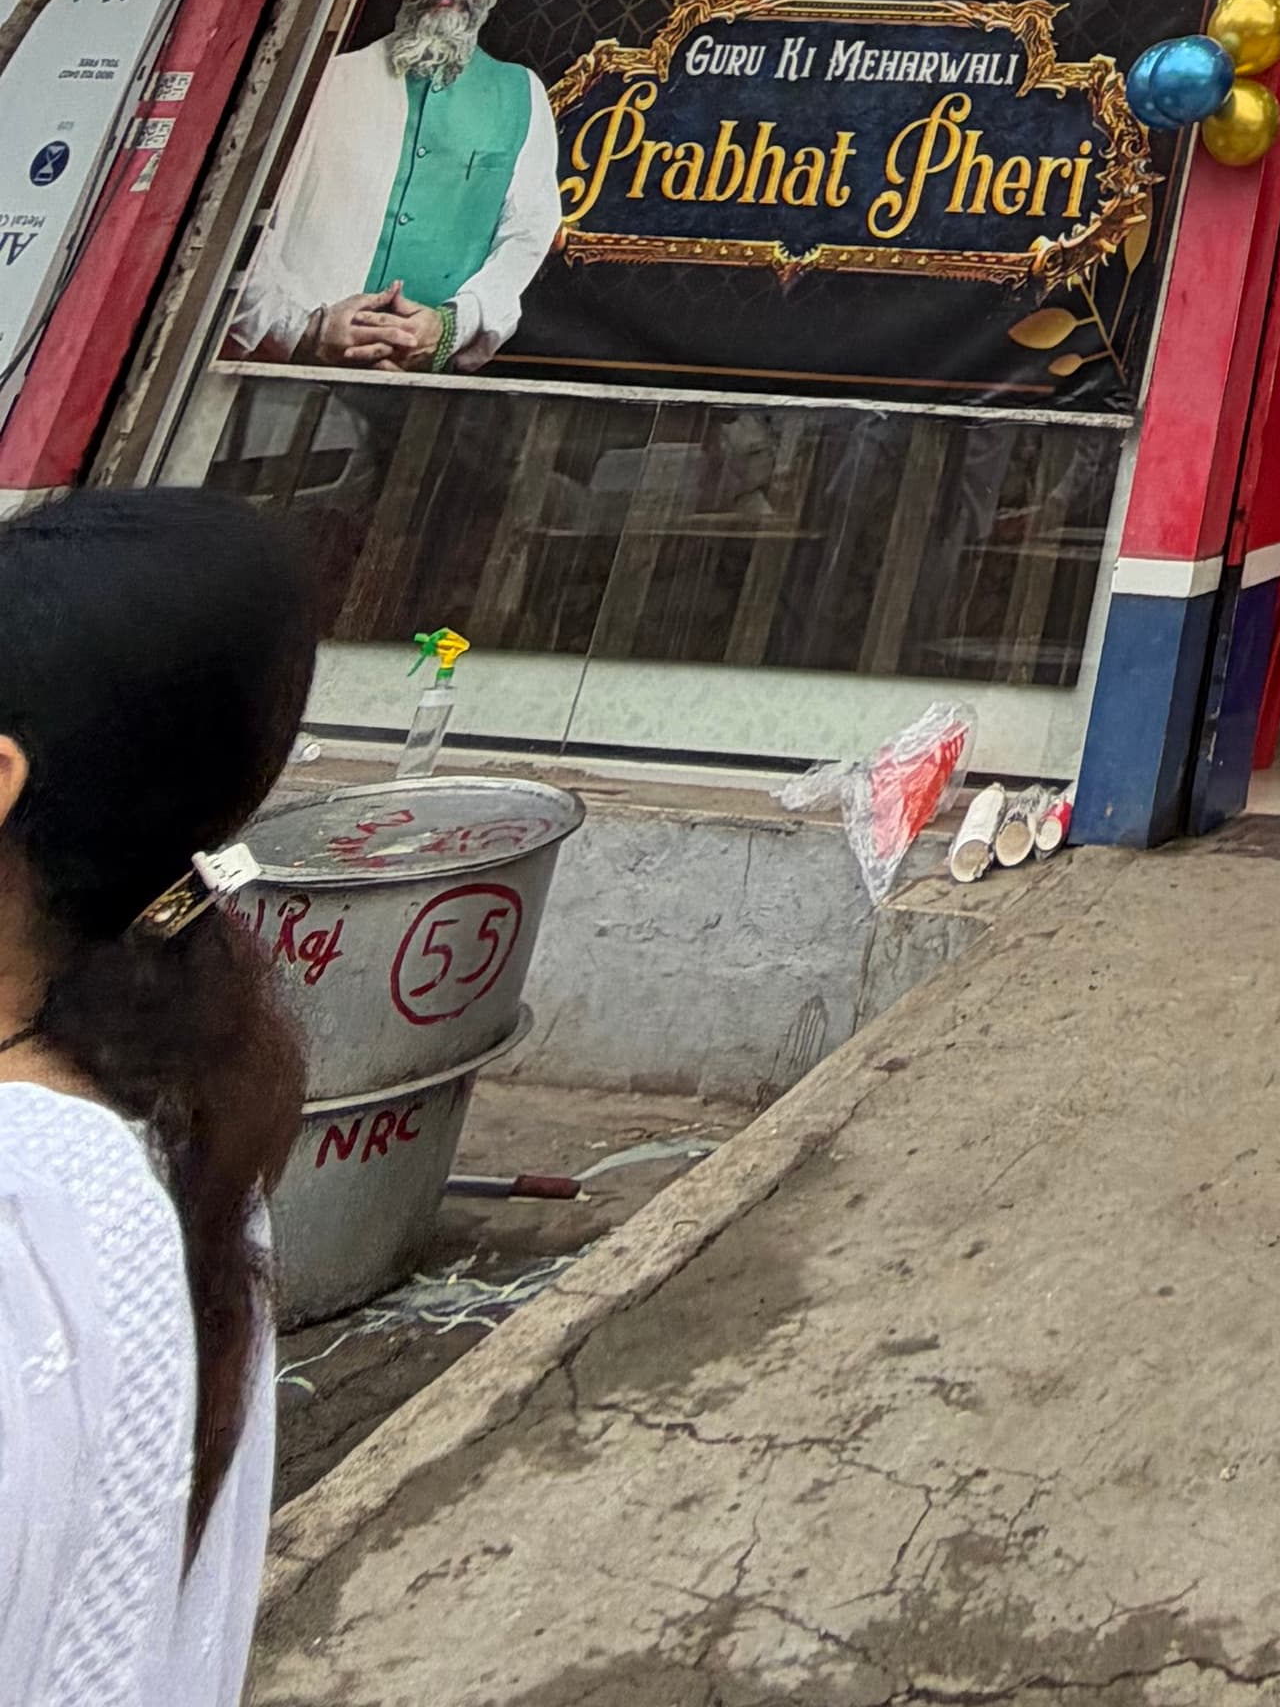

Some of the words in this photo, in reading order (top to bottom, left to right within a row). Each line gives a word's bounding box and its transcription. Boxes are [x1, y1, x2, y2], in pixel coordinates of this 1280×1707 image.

[560, 78, 855, 227] Prabhat
[867, 93, 1096, 240] Pheri
[409, 907, 511, 997] 55
